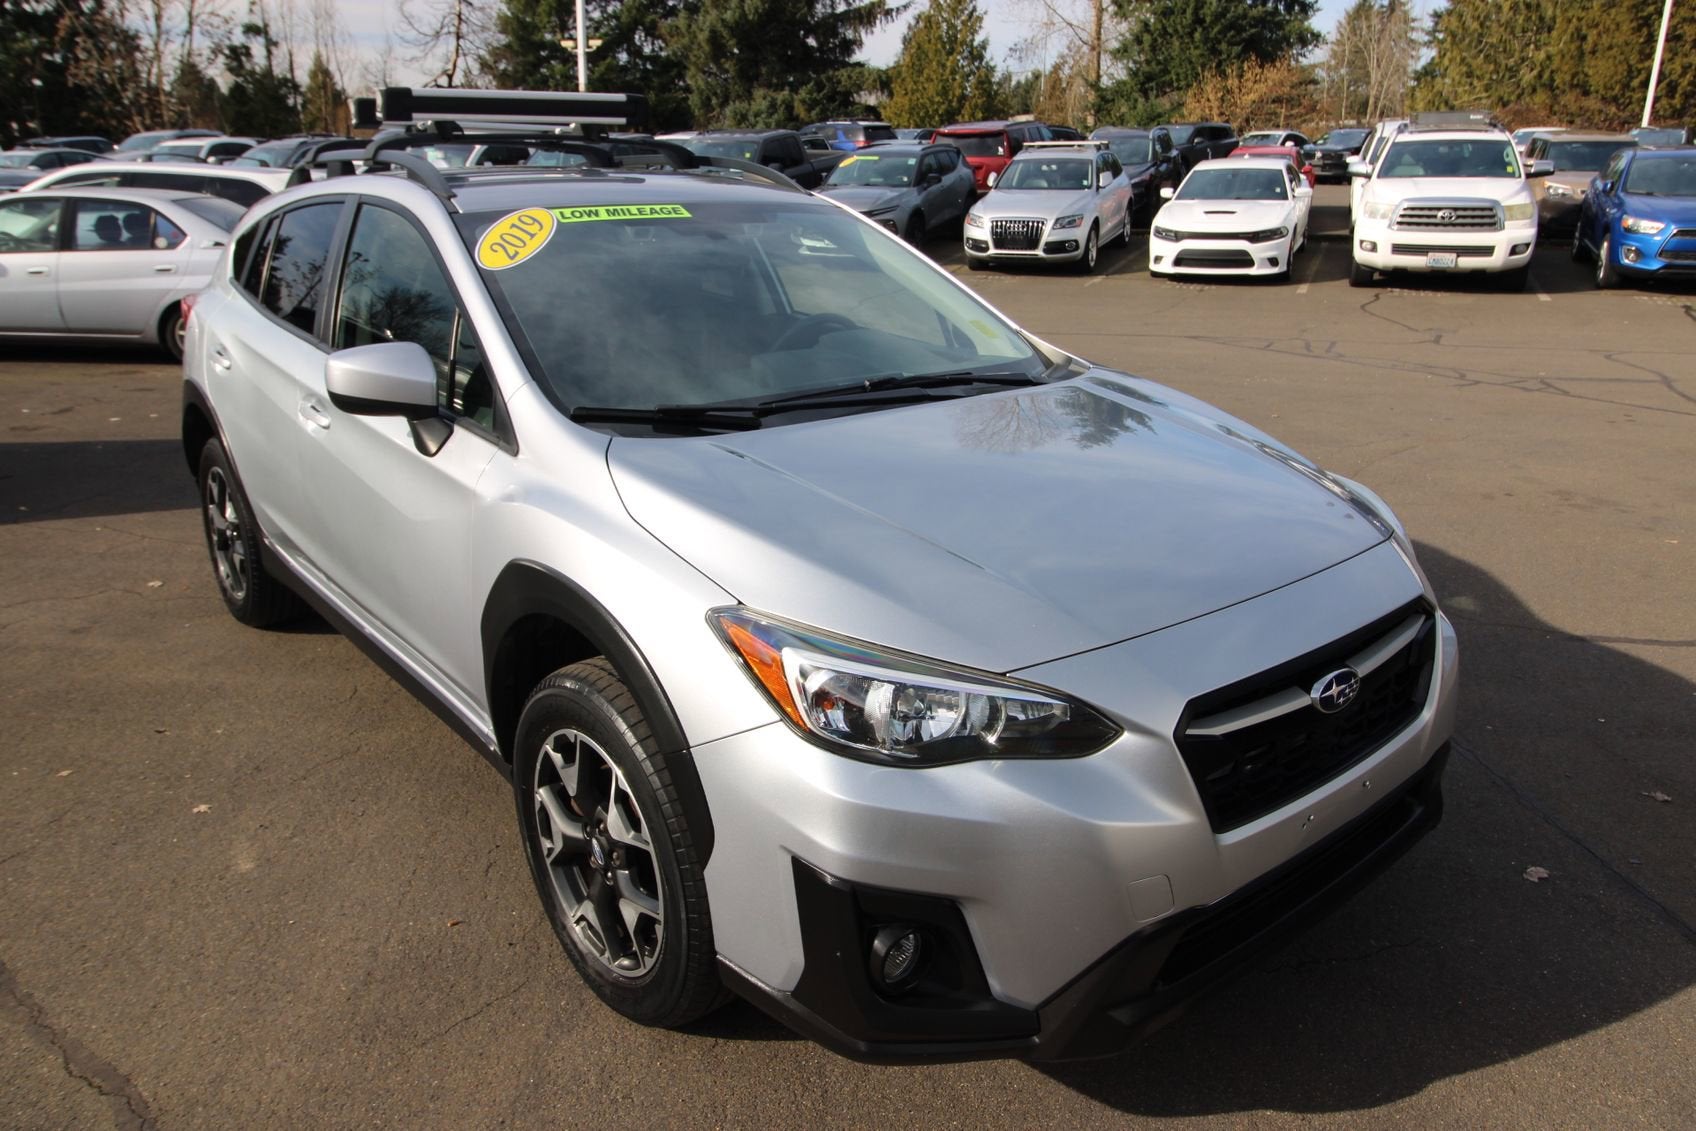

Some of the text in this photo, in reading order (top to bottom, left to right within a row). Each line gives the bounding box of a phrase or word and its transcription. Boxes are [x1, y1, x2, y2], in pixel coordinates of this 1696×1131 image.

[560, 206, 684, 219] LOW MILEAGE
[490, 214, 544, 261] 2019
